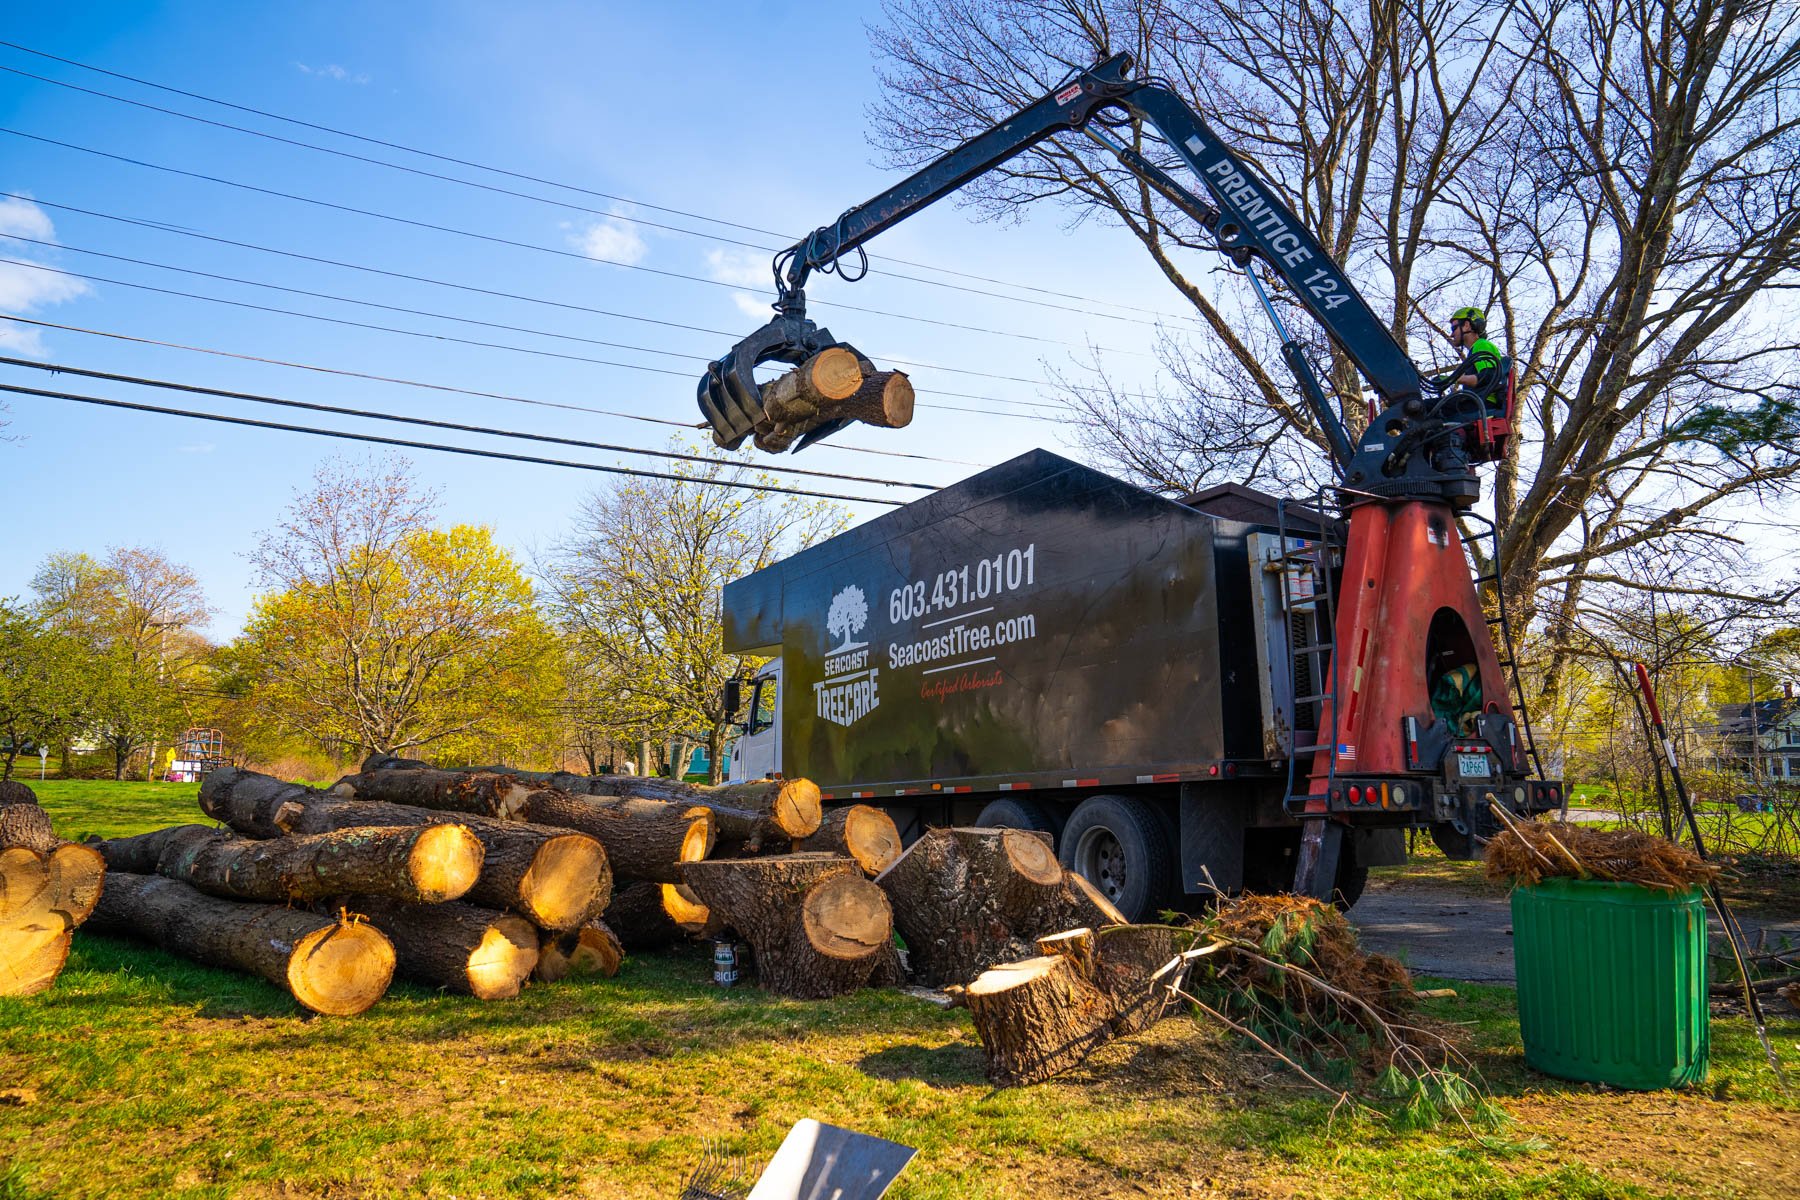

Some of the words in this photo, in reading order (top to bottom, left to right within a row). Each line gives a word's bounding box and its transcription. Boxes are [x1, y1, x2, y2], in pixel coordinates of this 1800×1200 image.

[1206, 159, 1314, 268] PRENTICE
[1303, 268, 1351, 310] 124
[890, 543, 1035, 624] 603.431.0101
[824, 650, 869, 677] SEACOAST
[889, 614, 1036, 670] SeacoastTree.com
[921, 675, 960, 705] Certified
[960, 669, 1003, 692] Arborists
